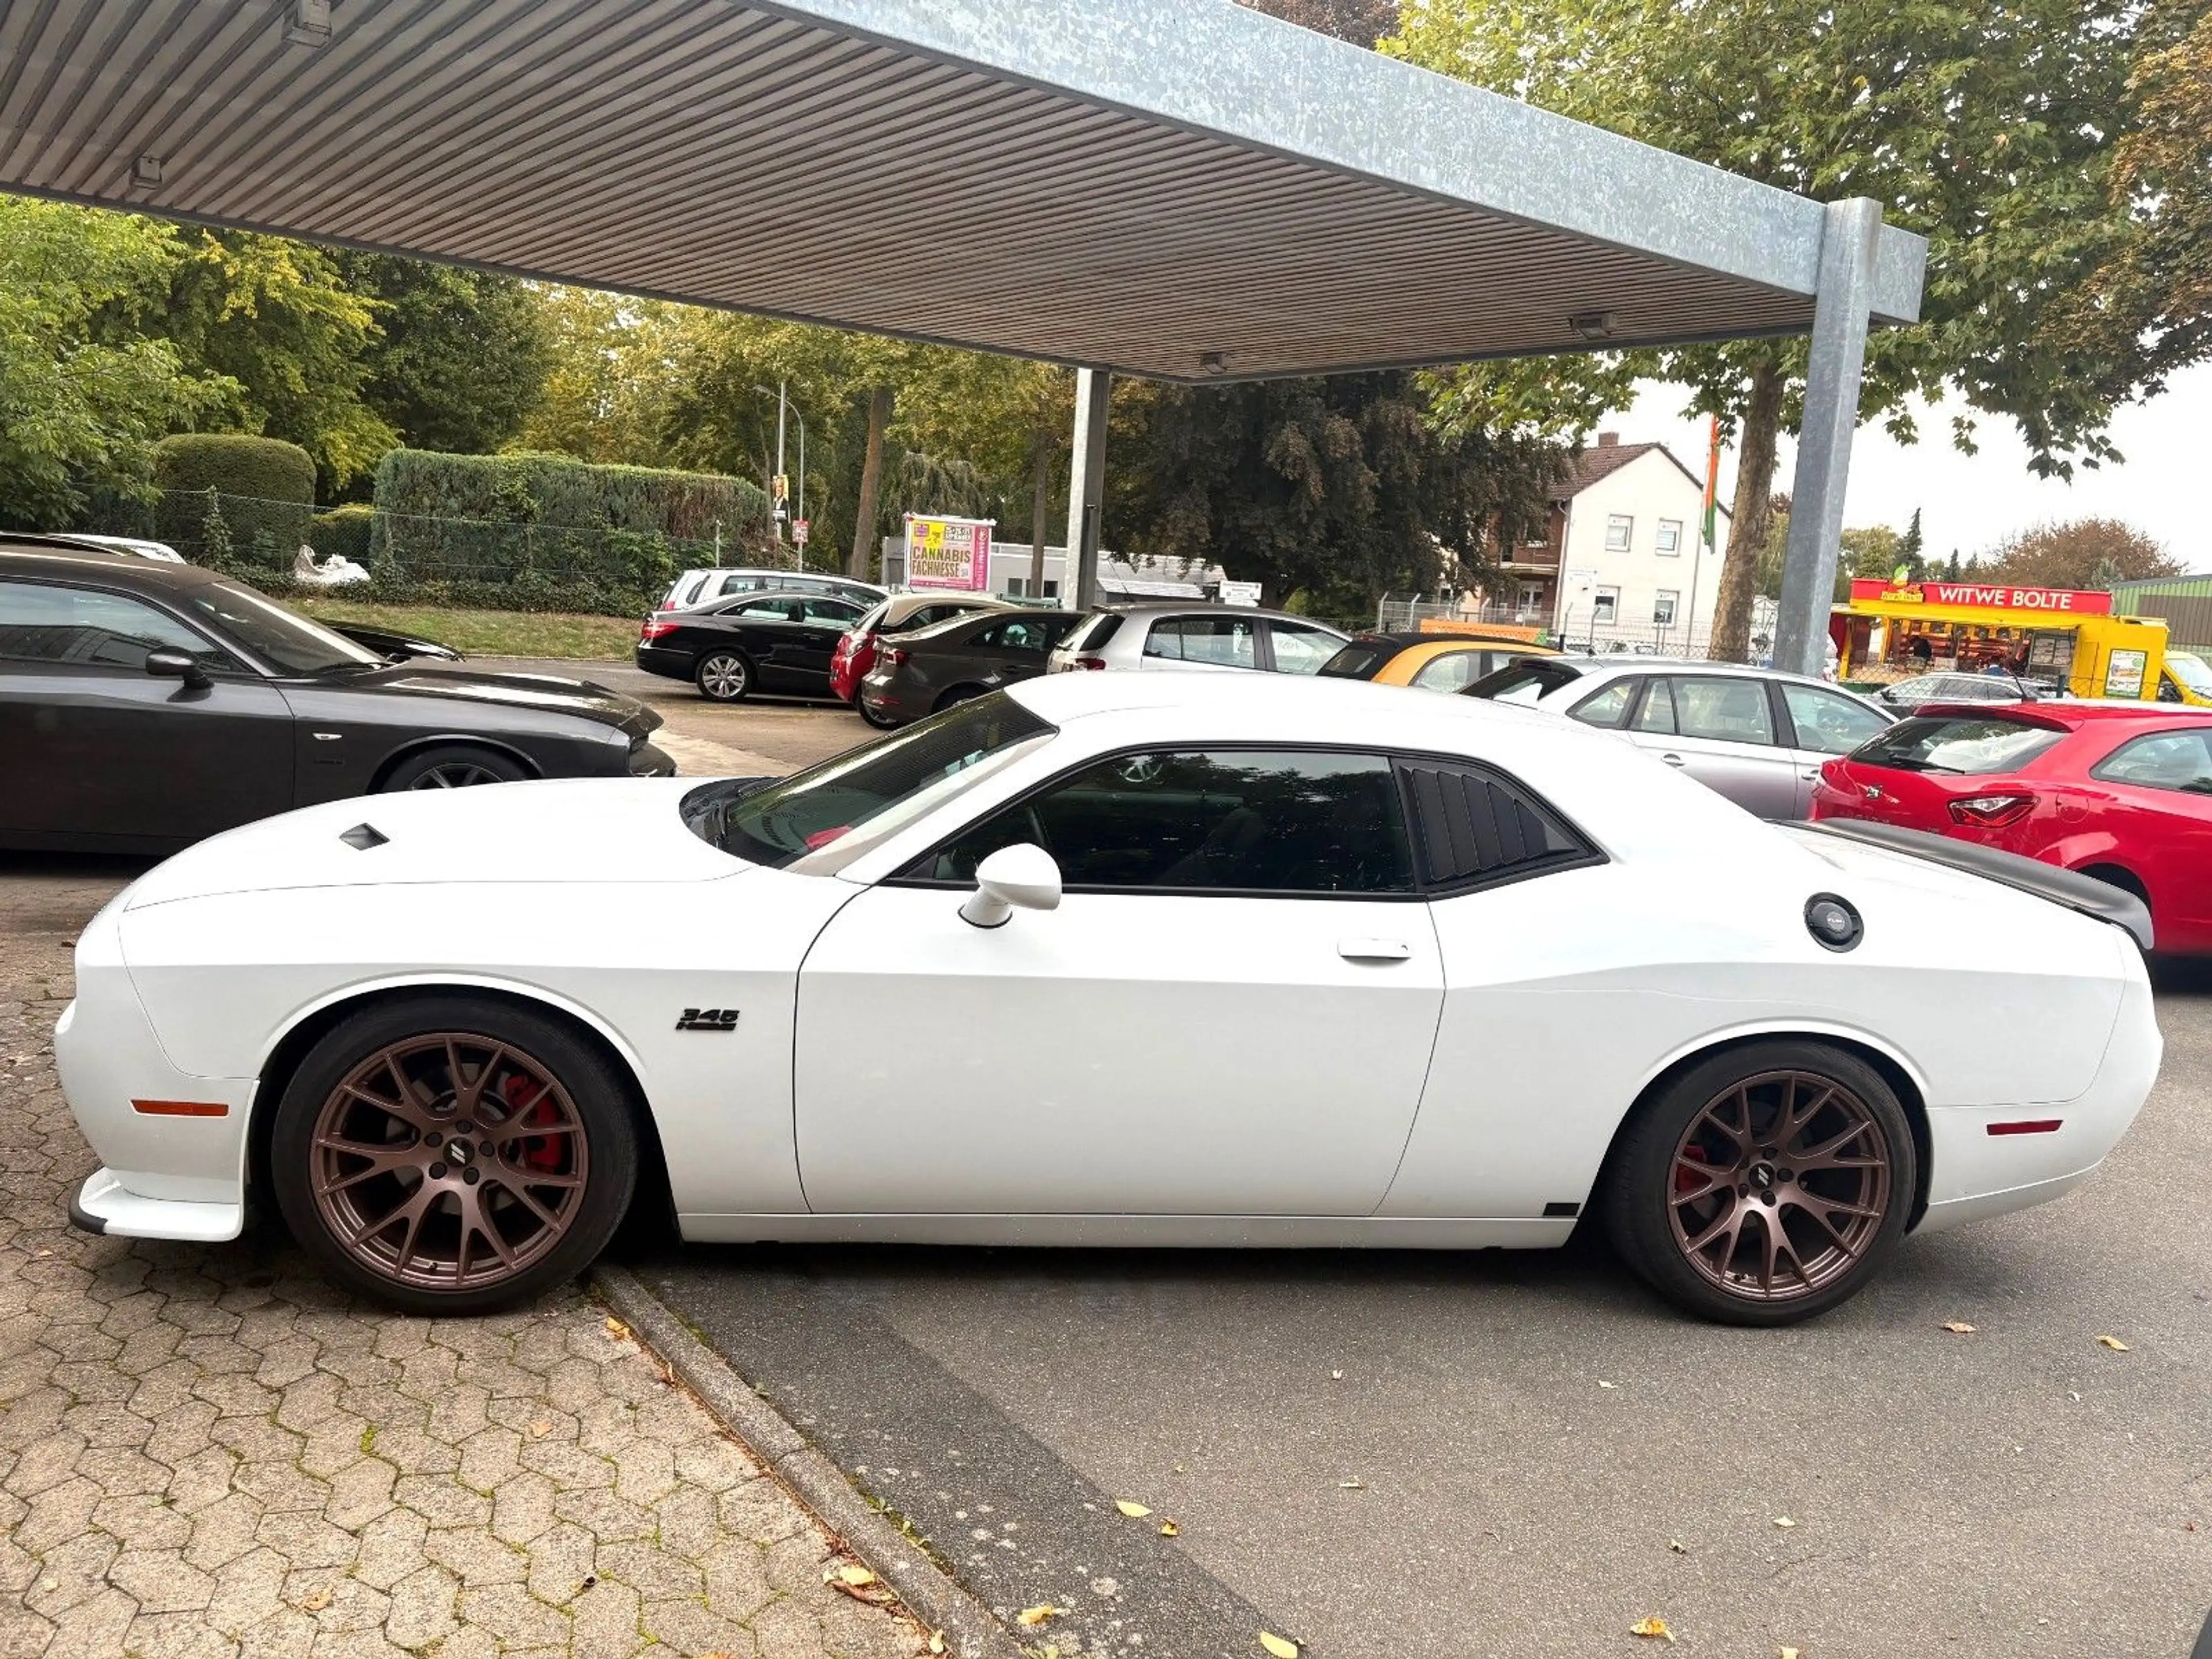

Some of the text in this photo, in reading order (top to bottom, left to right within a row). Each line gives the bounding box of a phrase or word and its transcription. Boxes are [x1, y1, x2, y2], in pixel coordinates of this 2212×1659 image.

[913, 546, 971, 563] CANNABIS
[912, 560, 960, 577] FACHMESSE
[1939, 586, 2006, 605] WITWE
[2012, 590, 2073, 609] BOLTE
